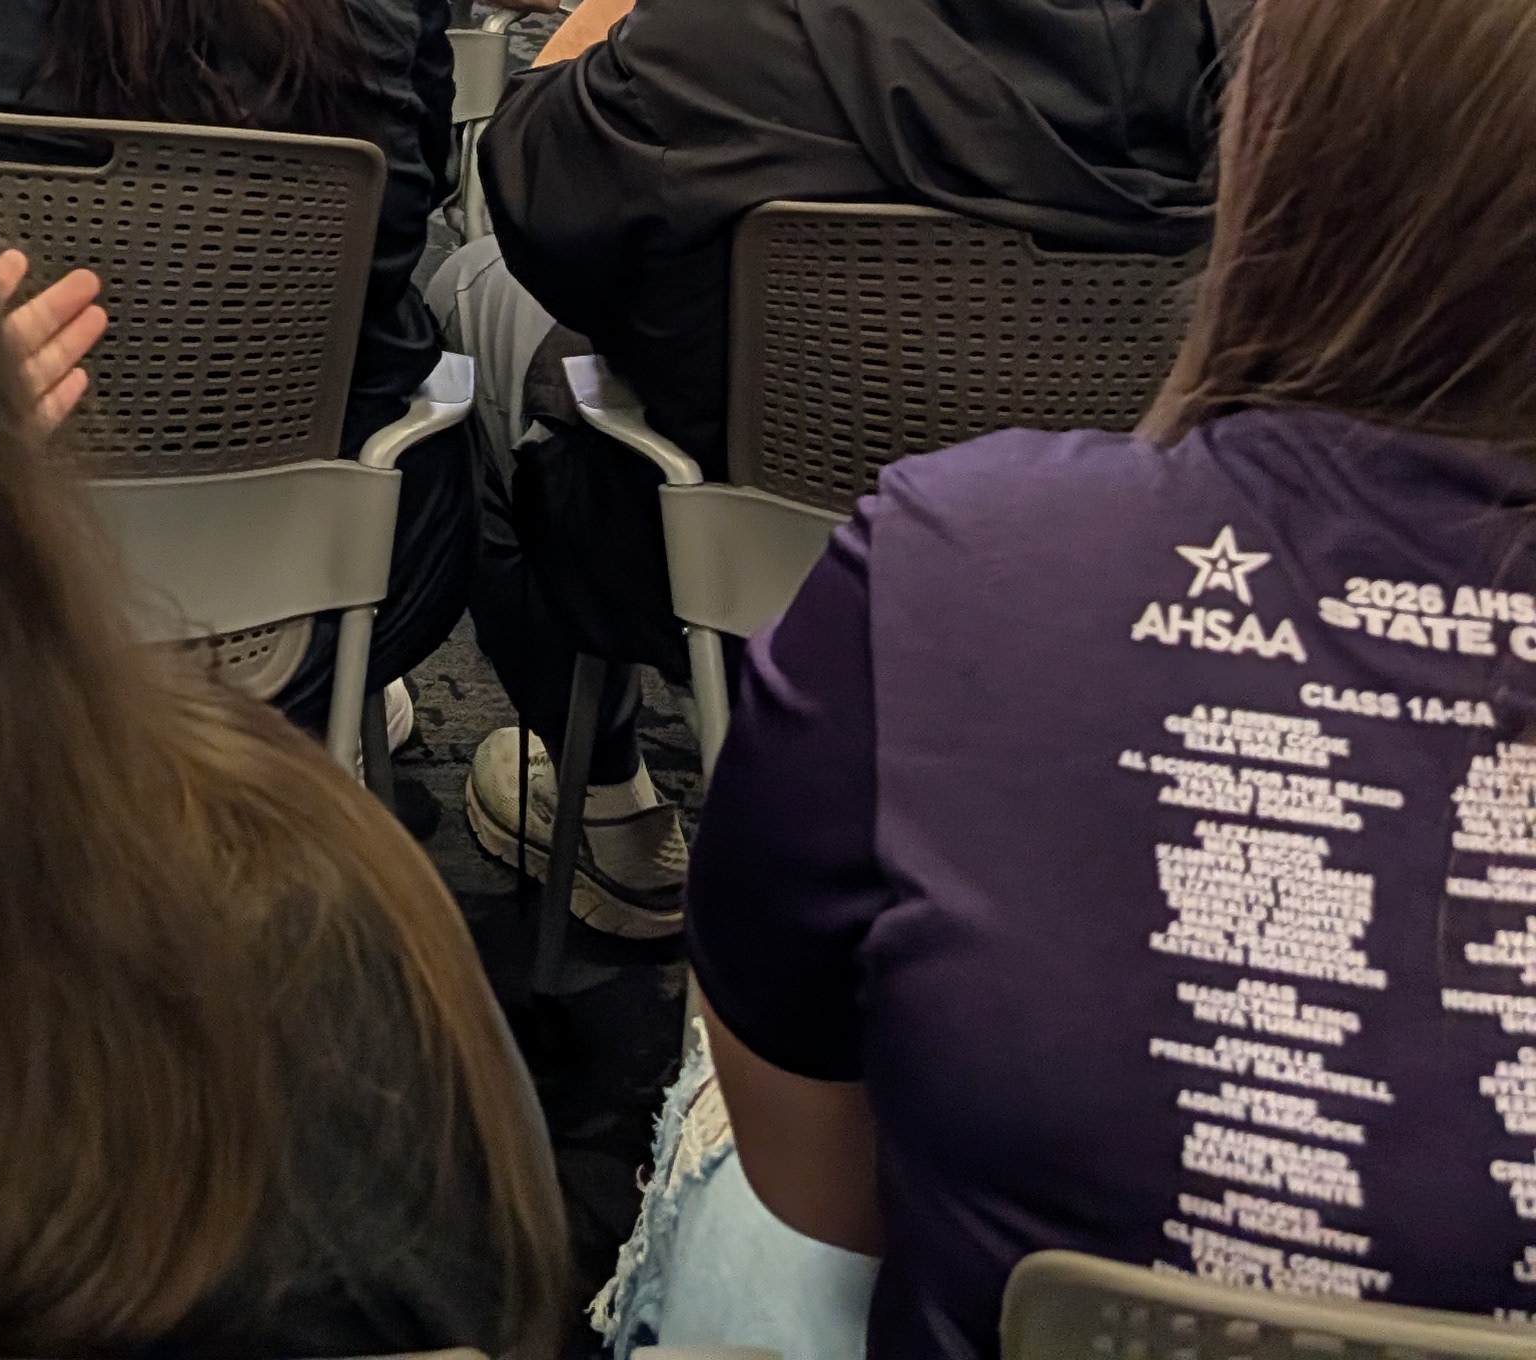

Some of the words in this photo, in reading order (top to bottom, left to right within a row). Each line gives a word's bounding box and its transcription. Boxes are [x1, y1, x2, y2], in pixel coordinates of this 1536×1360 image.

[1344, 576, 1445, 615] 2026
[1130, 600, 1308, 664] AHSAA
[1317, 595, 1498, 657] STATE
[1299, 682, 1402, 720] CLASS
[1406, 695, 1496, 728] 1A-5A
[1149, 753, 1235, 782] SCHOOL
[1239, 766, 1284, 787] FOR
[1286, 773, 1332, 796] THE
[1335, 780, 1405, 810] BLIND
[1252, 1058, 1396, 1106] BLACKWELL
